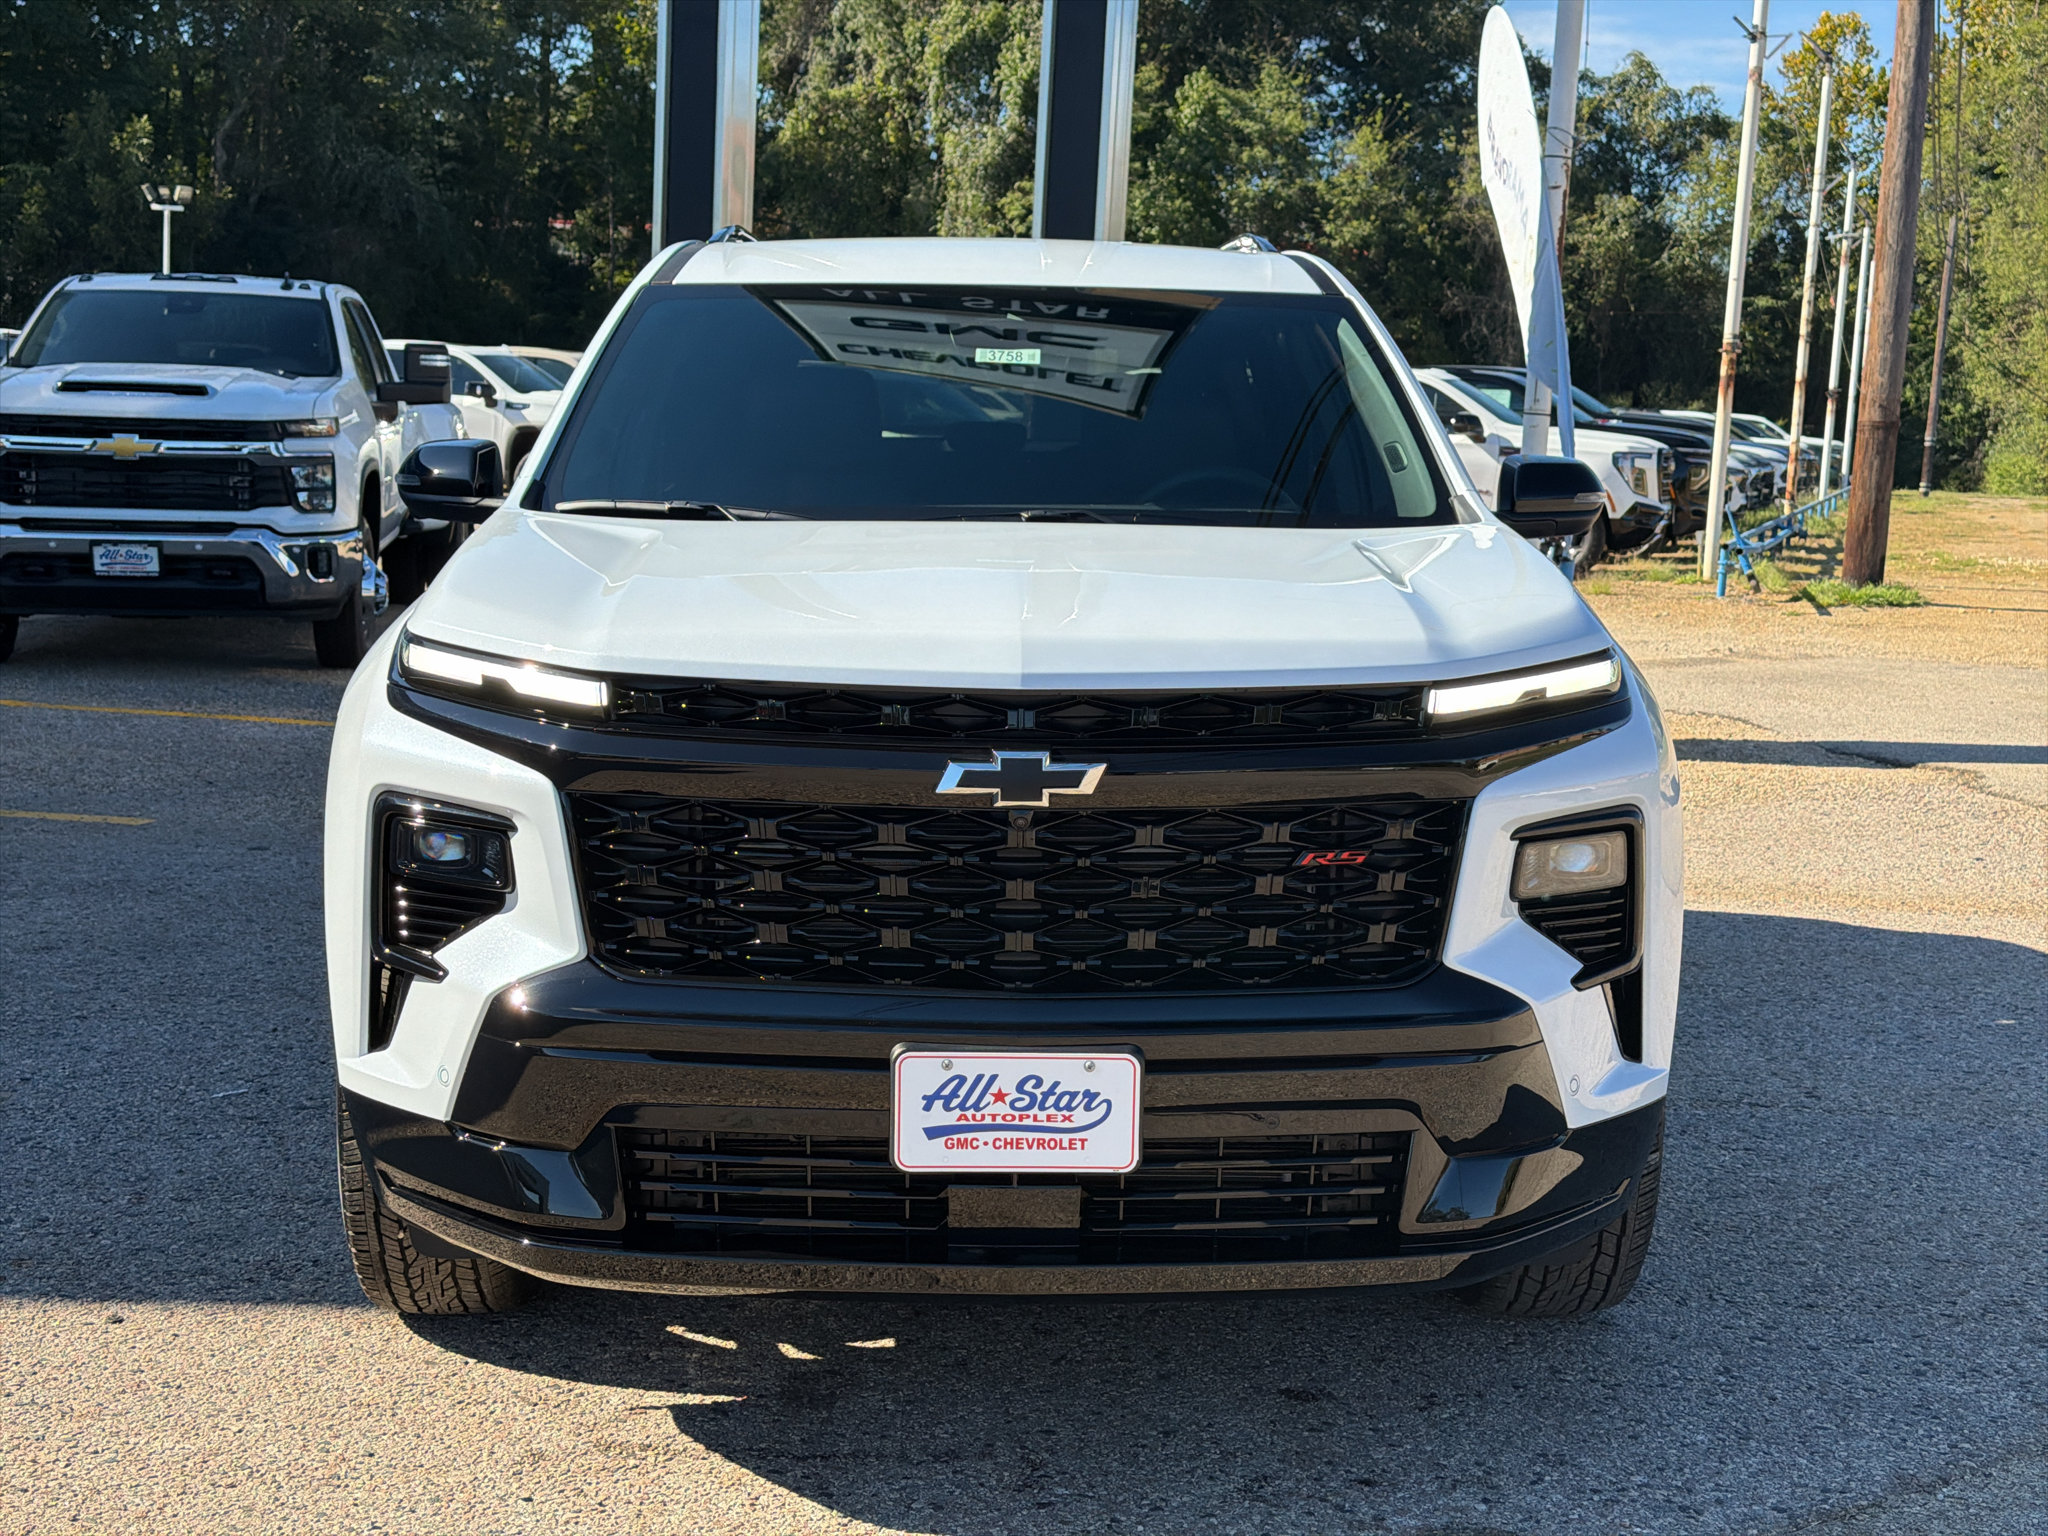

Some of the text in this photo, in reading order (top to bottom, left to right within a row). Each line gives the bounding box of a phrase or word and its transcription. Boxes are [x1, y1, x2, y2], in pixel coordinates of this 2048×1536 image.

[988, 350, 1023, 362] 3758
[1300, 850, 1368, 866] RS
[955, 1113, 1075, 1123] AUTOPLEX
[944, 1137, 1089, 1151] GMC CHEVROLET
